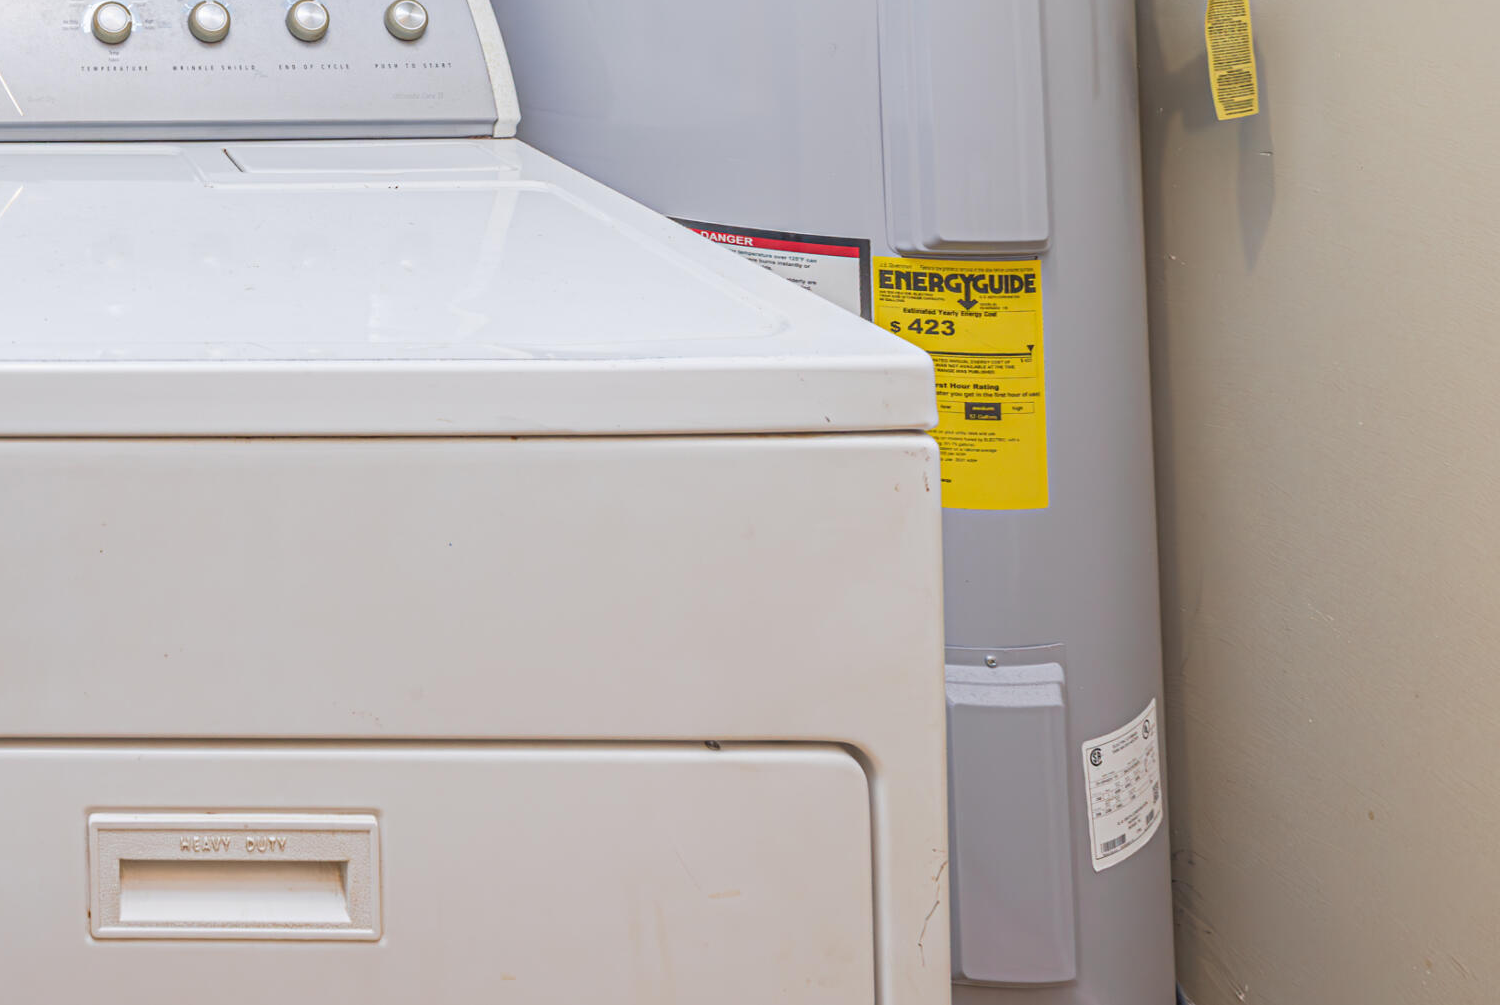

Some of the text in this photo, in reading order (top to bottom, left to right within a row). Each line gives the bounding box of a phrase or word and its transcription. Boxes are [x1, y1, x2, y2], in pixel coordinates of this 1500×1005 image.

[700, 230, 754, 246] DANGER
[878, 270, 1036, 294] ENERGYGUIDE
[903, 308, 936, 316] Estimated
[890, 318, 956, 336] $ 423
[180, 836, 288, 853] HEAVY DUTY
